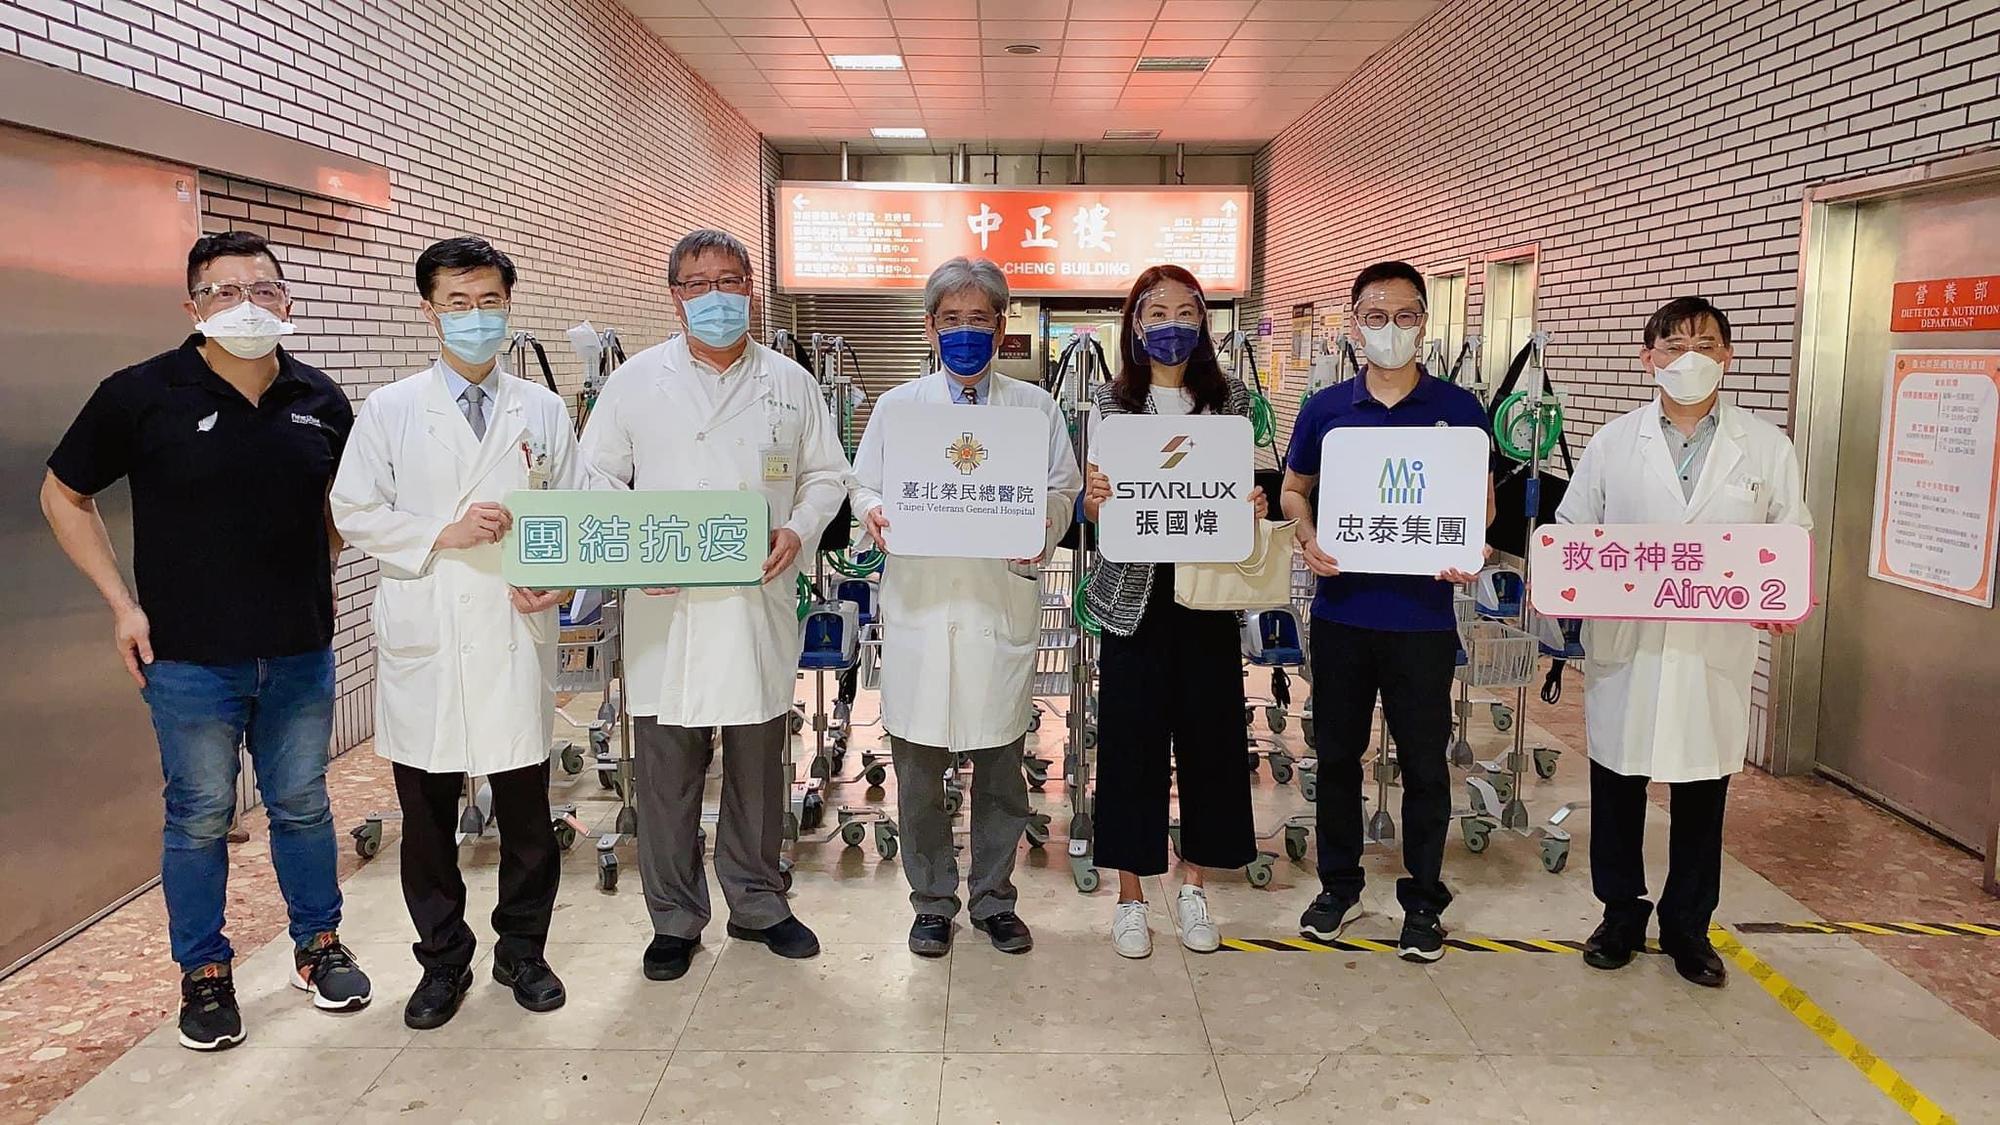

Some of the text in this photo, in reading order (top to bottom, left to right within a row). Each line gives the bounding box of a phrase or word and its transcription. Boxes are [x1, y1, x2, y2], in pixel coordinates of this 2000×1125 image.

[967, 203, 1117, 252] 中正樓
[1061, 262, 1130, 275] BUILDING
[1915, 281, 1989, 305] 營養部
[1901, 304, 2000, 318] DIETETICS & NUTRITION
[1921, 317, 1974, 328] DEPARTMENT
[902, 481, 1034, 503] 臺北榮民總醫院
[1116, 481, 1237, 499] STARLUX
[896, 502, 1036, 517] Taipei Veterans General Hospital
[1136, 509, 1219, 536] 張國煒
[1336, 514, 1467, 546] 忠泰集團
[519, 514, 748, 564] 團結抗疫
[1562, 541, 1705, 572] 救命神器
[1654, 578, 1787, 610] Airvo 2
